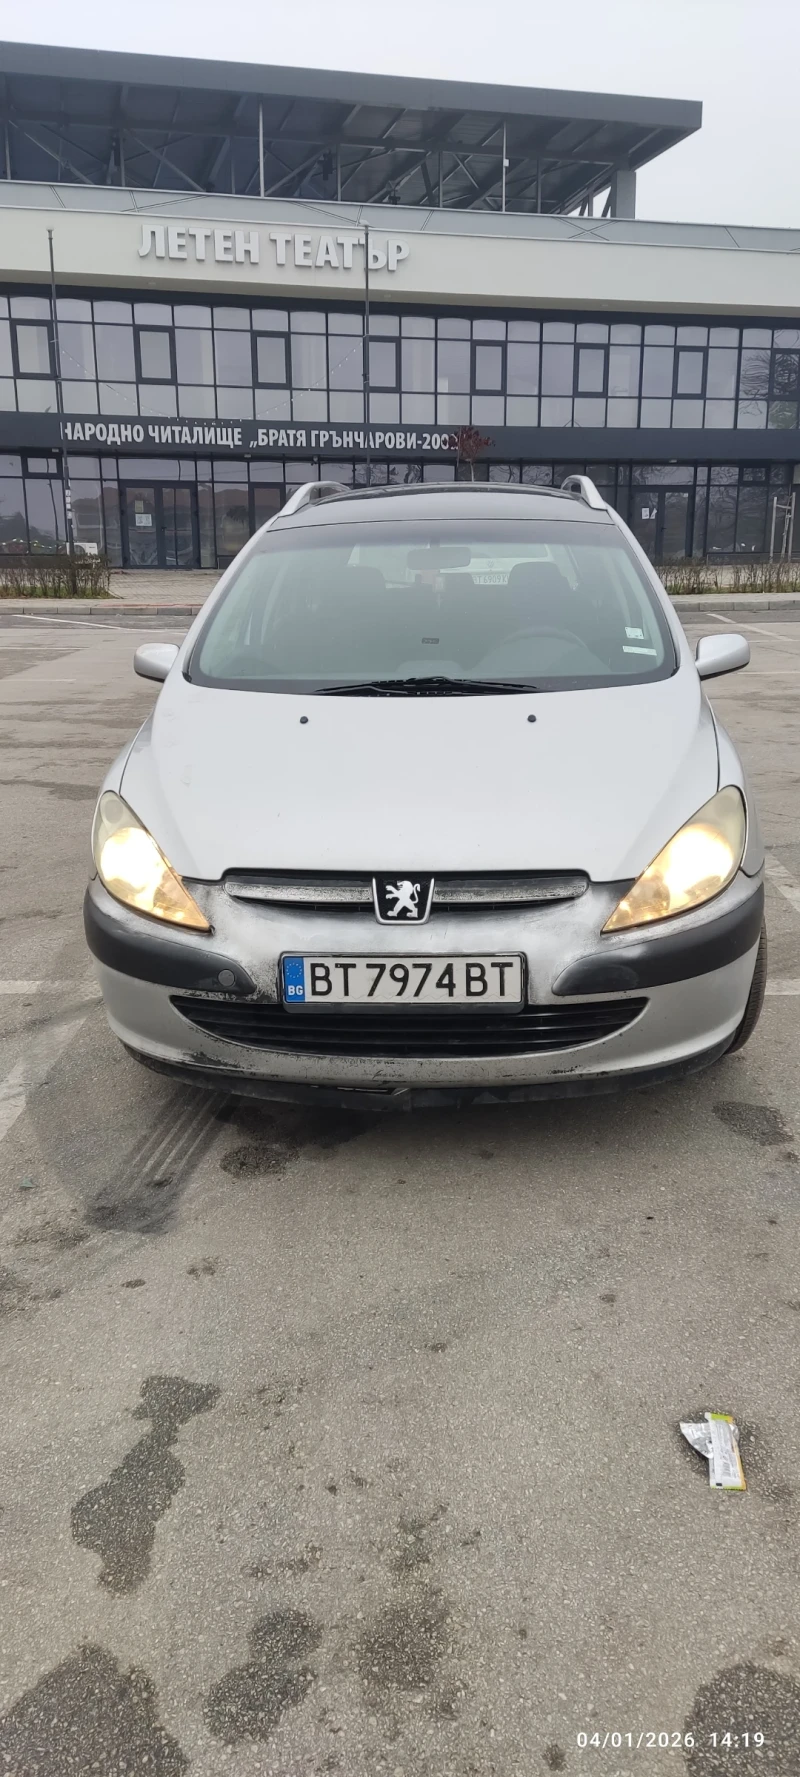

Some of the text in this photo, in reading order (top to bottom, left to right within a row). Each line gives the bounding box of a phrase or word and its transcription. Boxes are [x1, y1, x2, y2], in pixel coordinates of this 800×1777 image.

[138, 224, 410, 271] ЛЕТЕН ТЕАТЪР
[60, 422, 144, 445] НАРОДНО
[148, 425, 242, 448] ЧИТАЛИЩЕ
[287, 985, 304, 996] BG
[310, 962, 513, 997] BT 7974 BT
